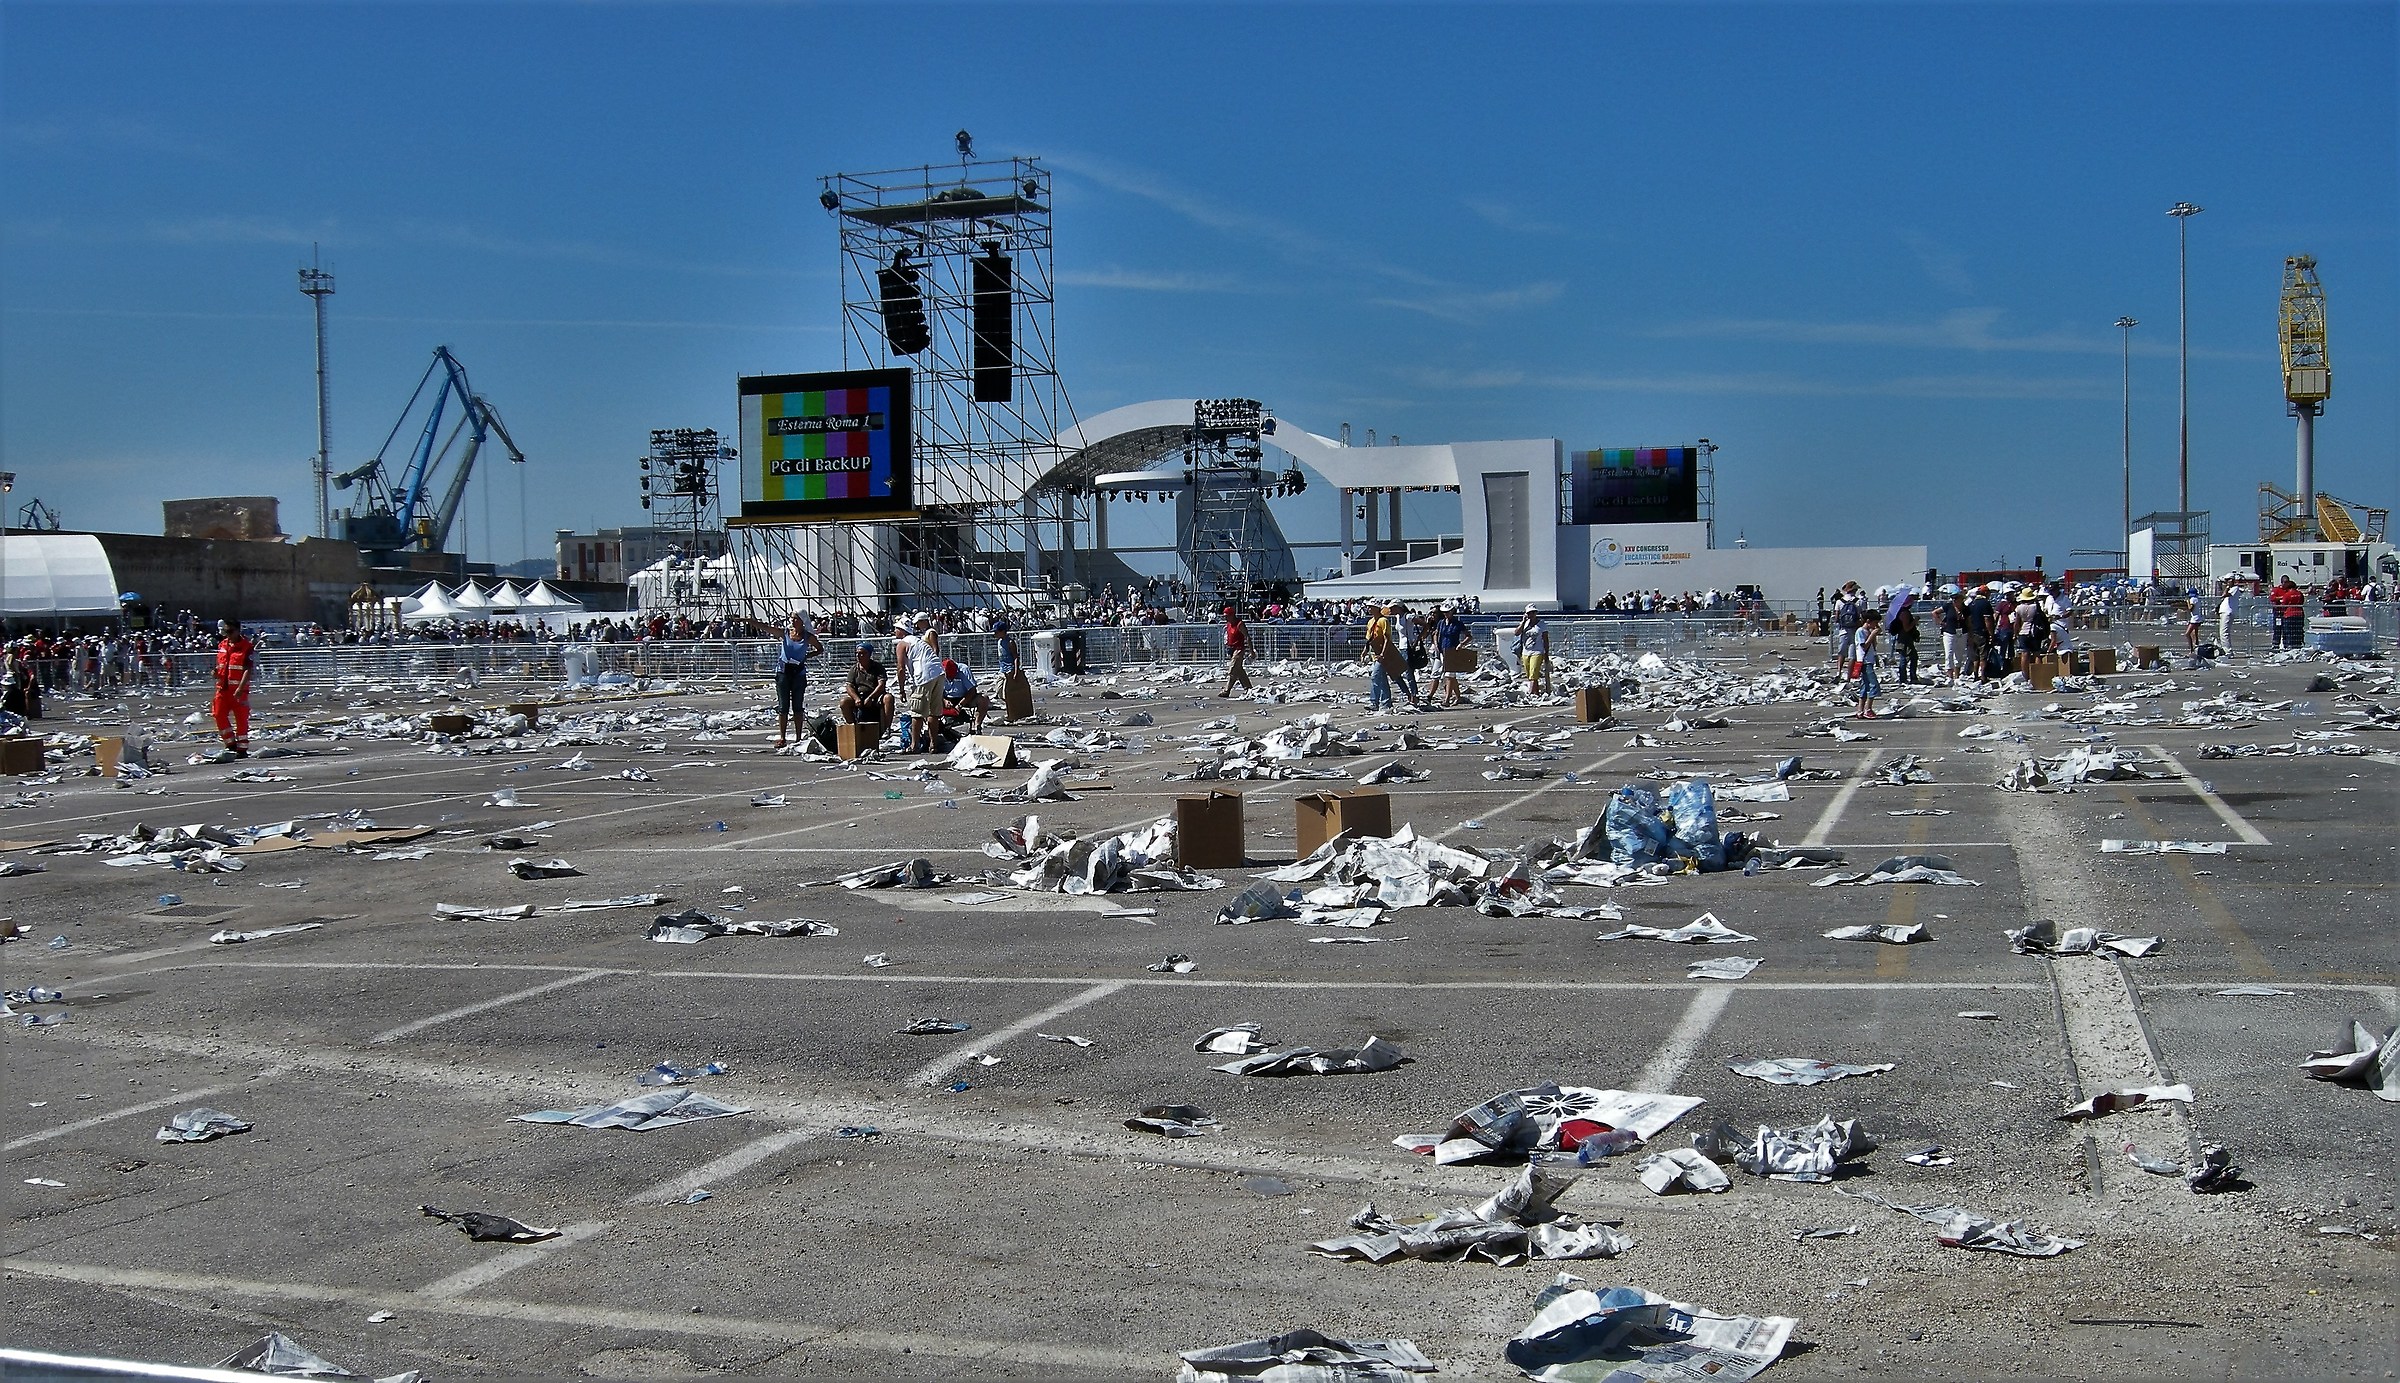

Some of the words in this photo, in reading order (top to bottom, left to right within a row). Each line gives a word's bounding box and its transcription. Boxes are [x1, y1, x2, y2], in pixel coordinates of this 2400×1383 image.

[778, 418, 822, 430] Esterna
[825, 416, 859, 430] Roma
[863, 415, 870, 428] 1
[771, 460, 791, 473] PG
[796, 458, 810, 472] di
[815, 456, 871, 472] BackUP
